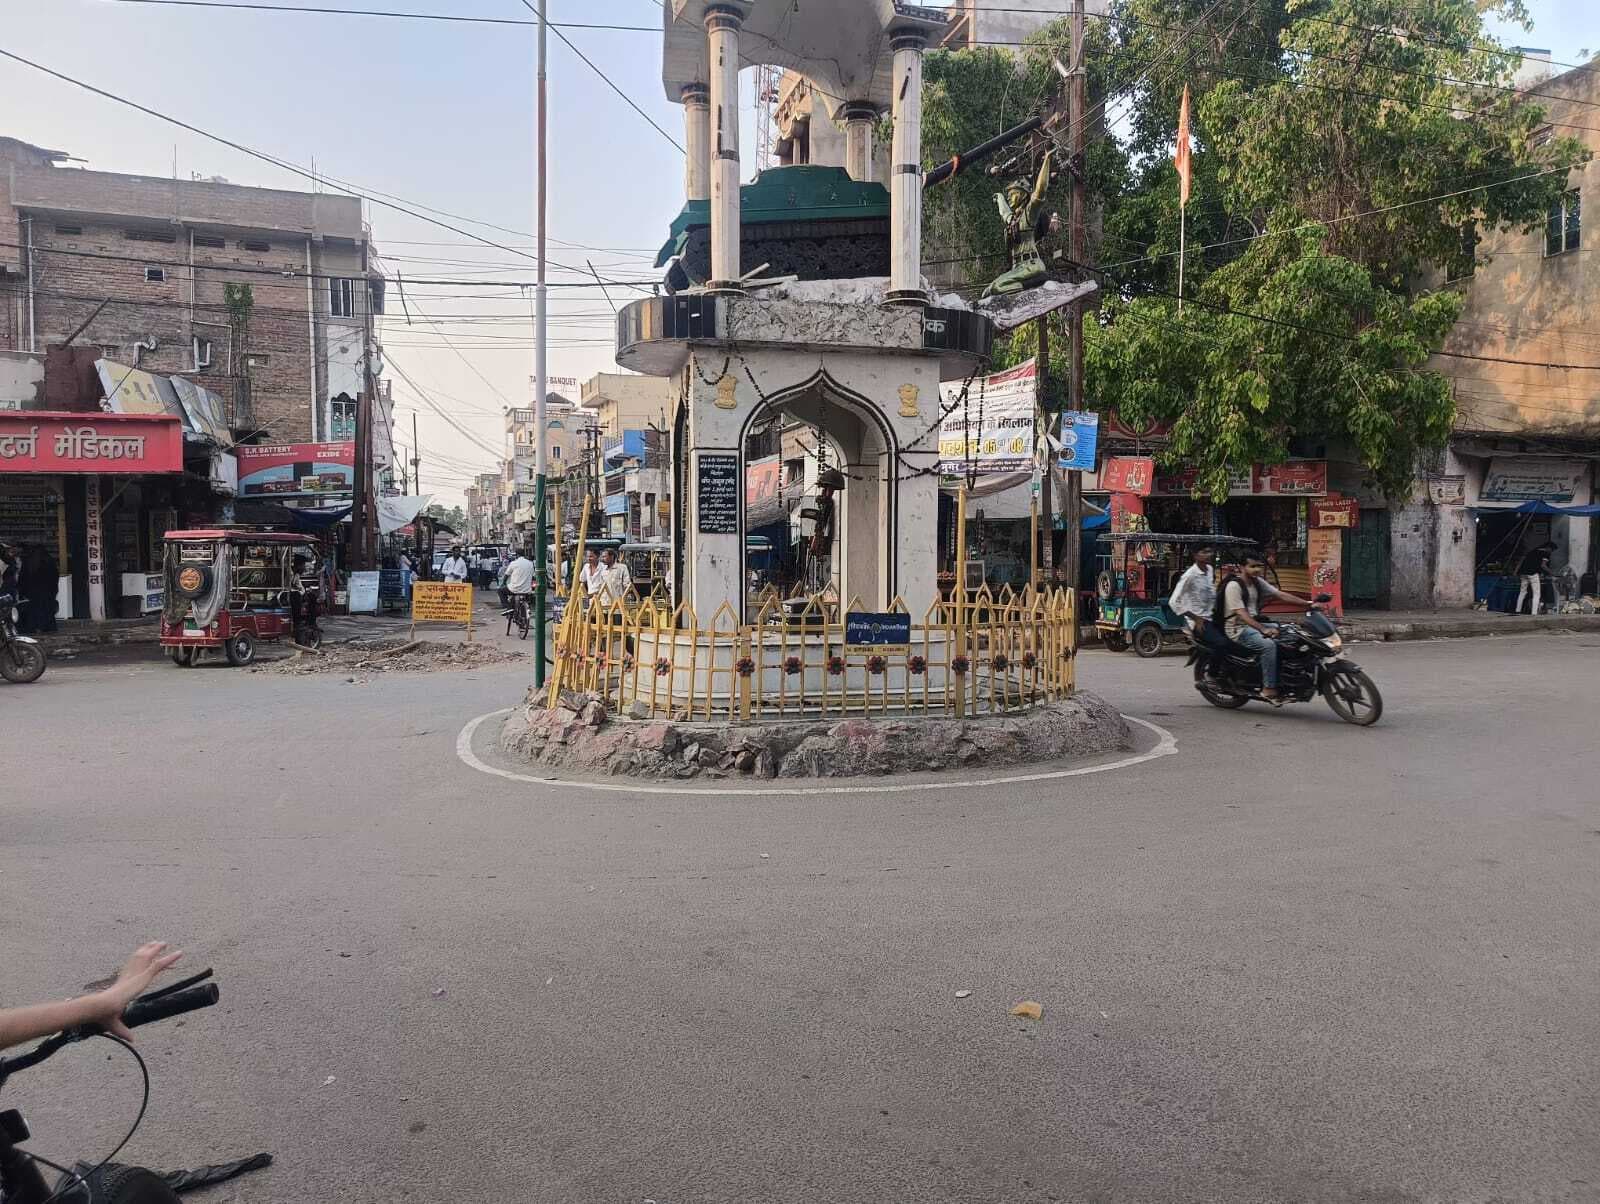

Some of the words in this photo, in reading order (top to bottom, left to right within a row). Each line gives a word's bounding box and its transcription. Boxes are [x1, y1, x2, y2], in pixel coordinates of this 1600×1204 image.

[549, 377, 577, 386] BANQUET
[998, 416, 1033, 429] खिलाफ
[54, 427, 144, 459] मेडिकल
